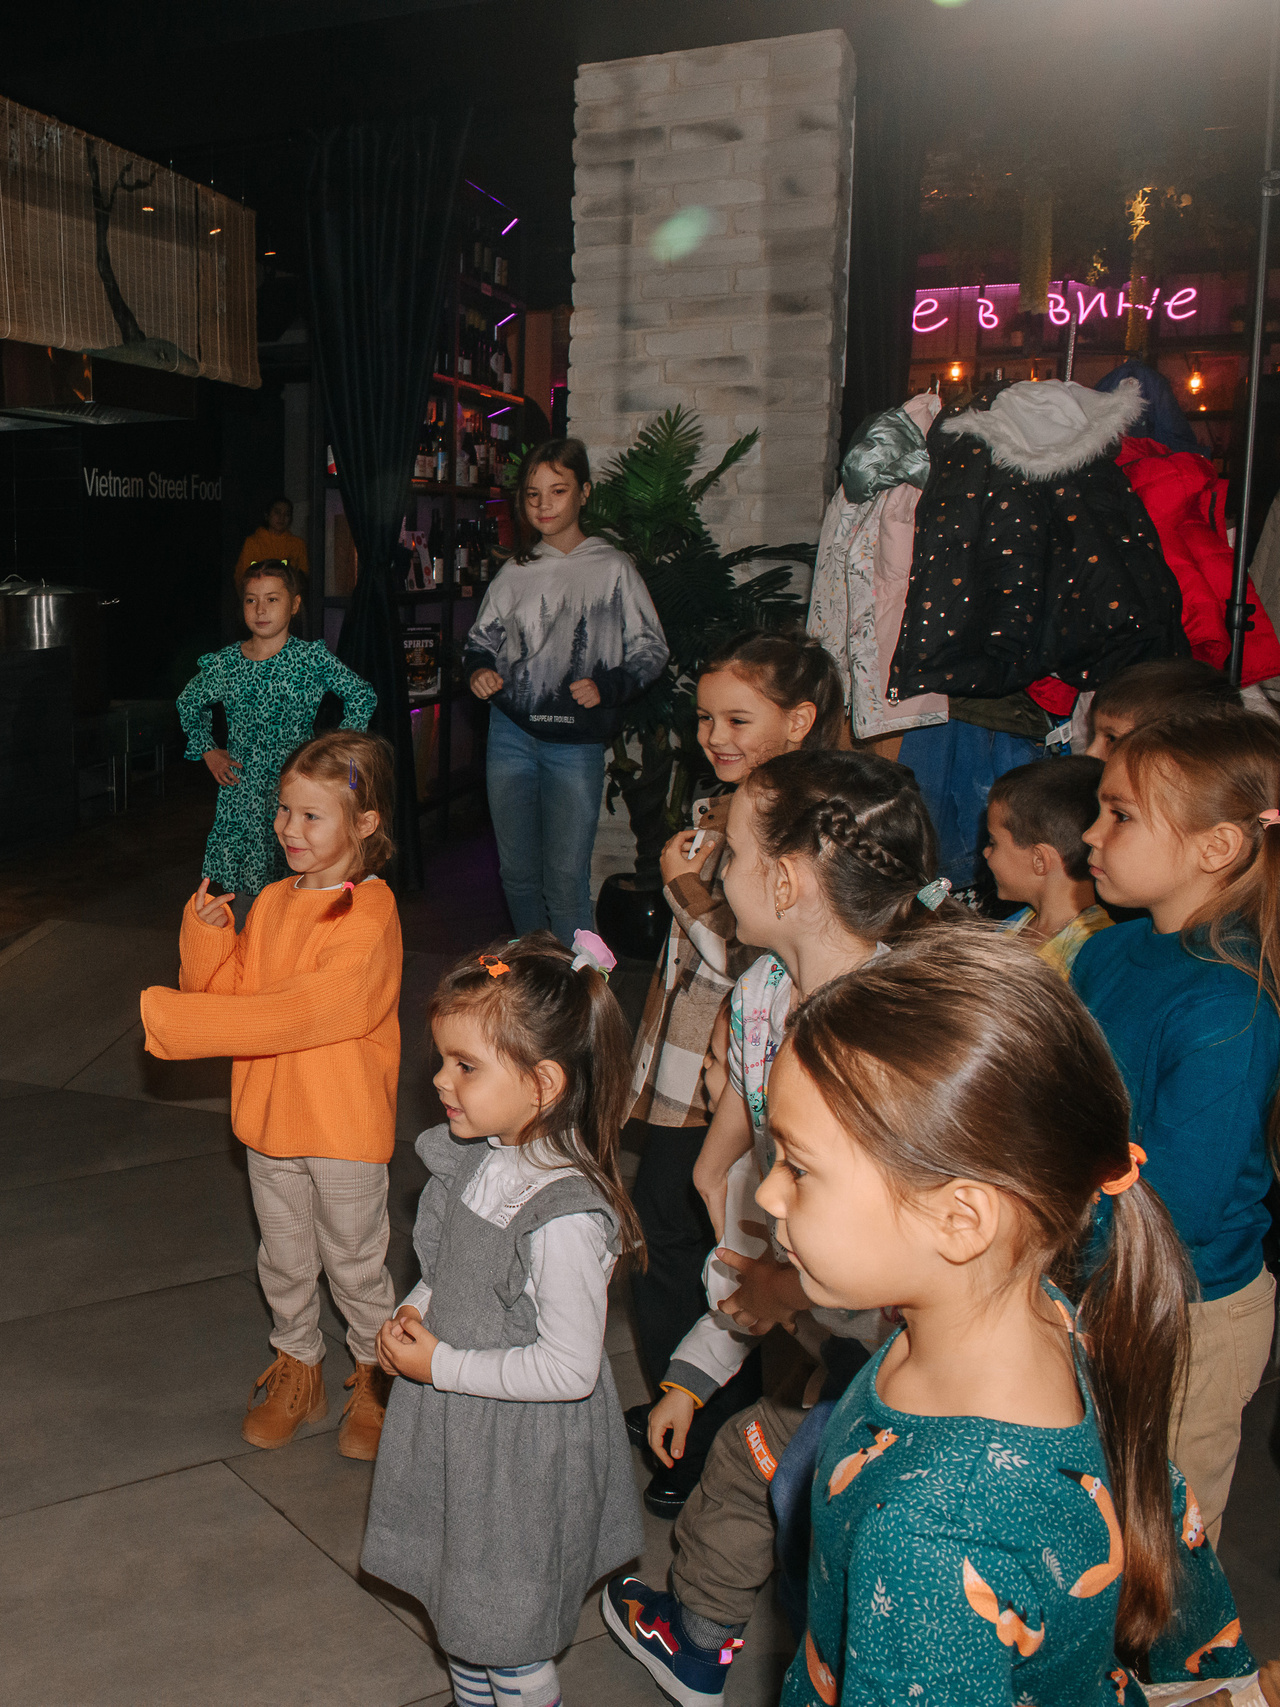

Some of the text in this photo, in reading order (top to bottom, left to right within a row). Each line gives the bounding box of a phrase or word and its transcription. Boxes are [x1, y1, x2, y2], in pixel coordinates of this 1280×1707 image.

[1047, 287, 1198, 325] вине
[83, 467, 222, 500] Vietnam Street Food
[403, 639, 434, 649] SPIRITS
[529, 714, 575, 724] DISAPPEAR TROUBLES
